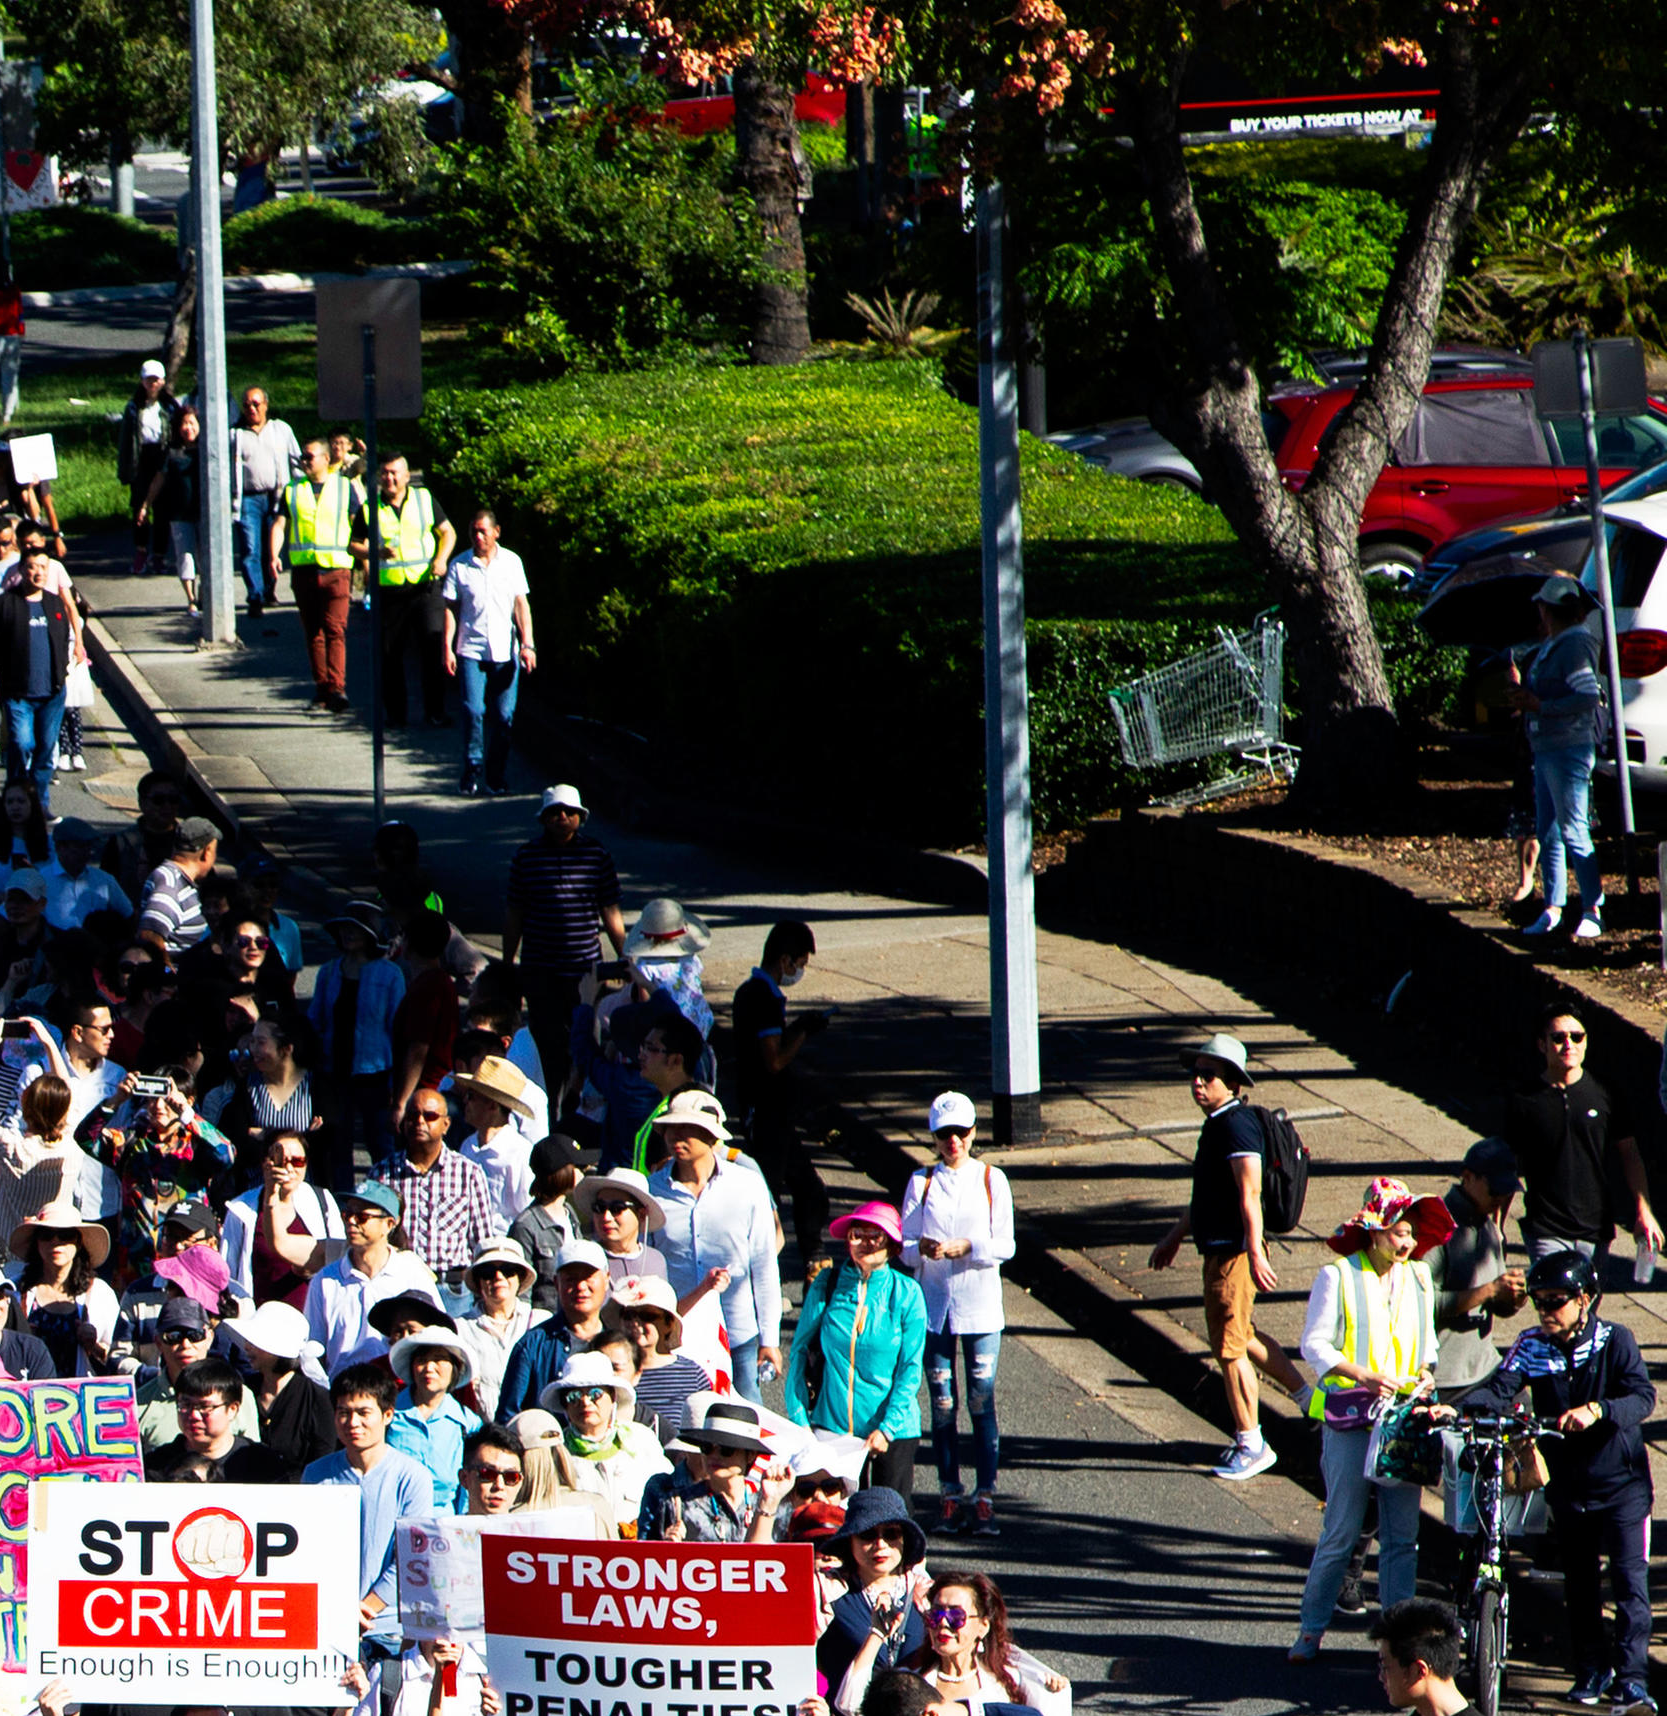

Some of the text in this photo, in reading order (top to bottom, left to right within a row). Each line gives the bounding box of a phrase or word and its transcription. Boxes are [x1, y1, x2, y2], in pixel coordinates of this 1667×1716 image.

[1230, 118, 1261, 133] BUY
[1262, 116, 1304, 132] YOUR
[1304, 112, 1363, 130] TICKETS
[1364, 111, 1401, 126] NOW
[1401, 109, 1423, 122] AT
[78, 1507, 299, 1581] STOP
[506, 1551, 789, 1593] STRONGER
[82, 1588, 287, 1638] CR!ME
[560, 1592, 718, 1639] LAWS,
[40, 1651, 350, 1685] Enough is Enough!!!
[524, 1650, 774, 1691] TOUGHER
